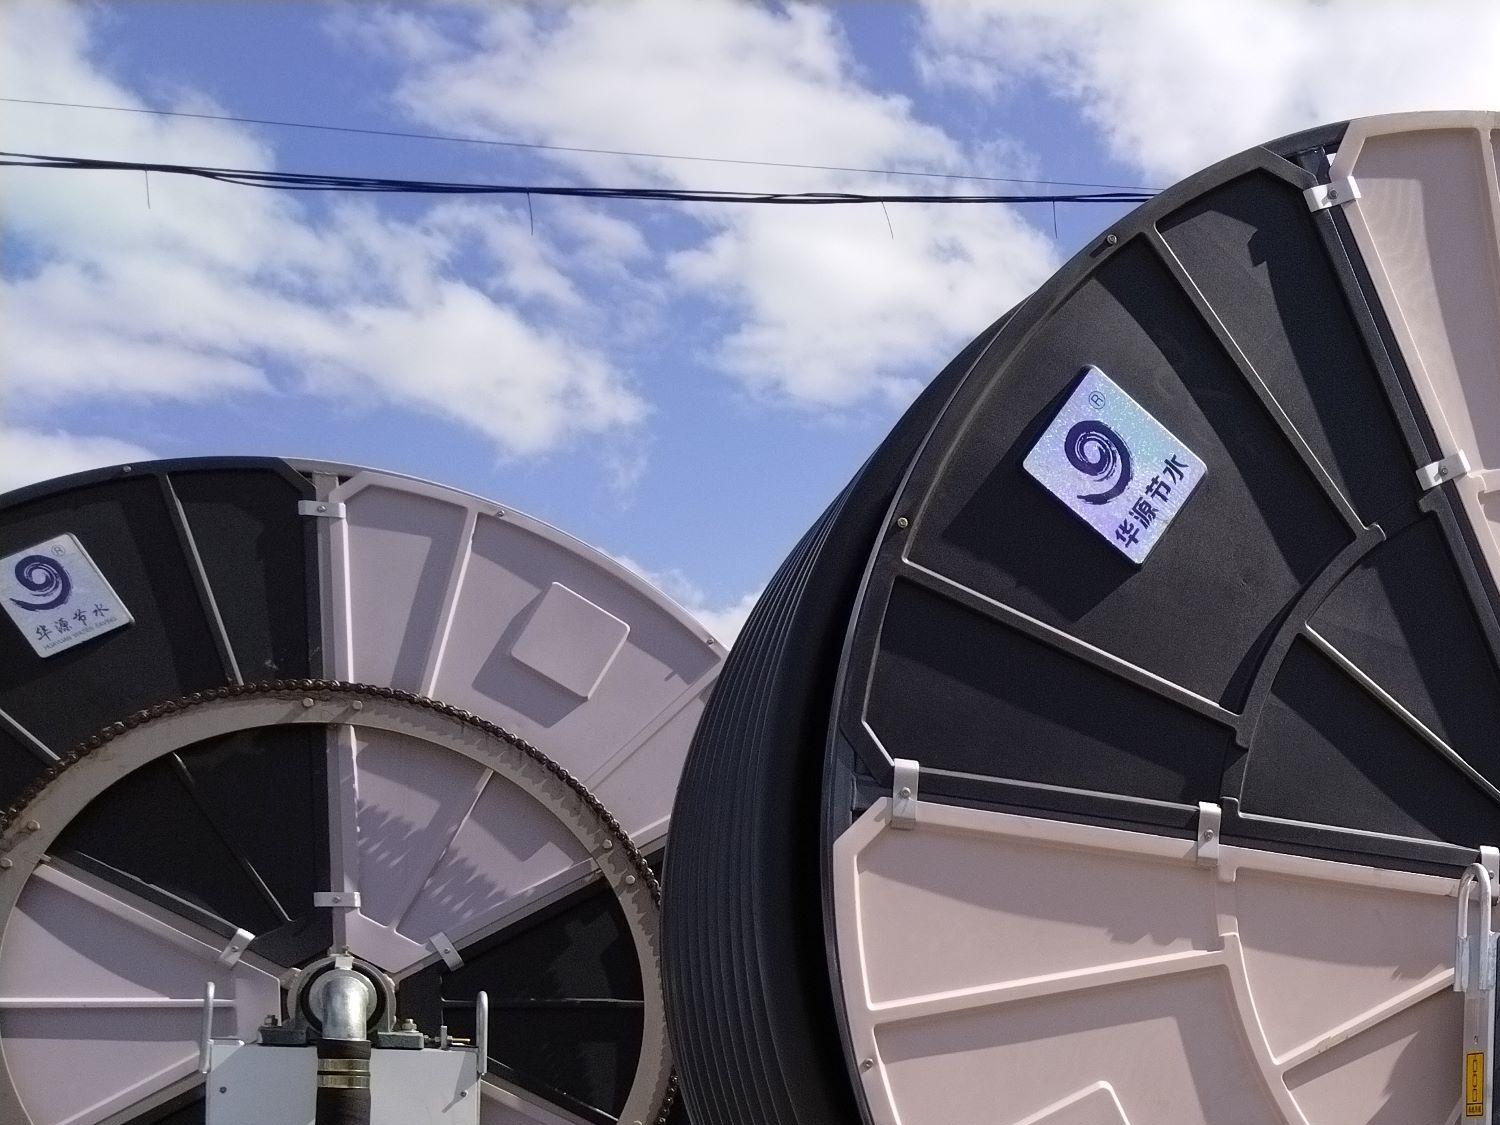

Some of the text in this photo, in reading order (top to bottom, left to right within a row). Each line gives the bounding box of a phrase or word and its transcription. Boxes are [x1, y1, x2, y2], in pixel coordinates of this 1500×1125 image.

[1115, 454, 1190, 548] 华源节水
[36, 603, 110, 641] 华源节水
